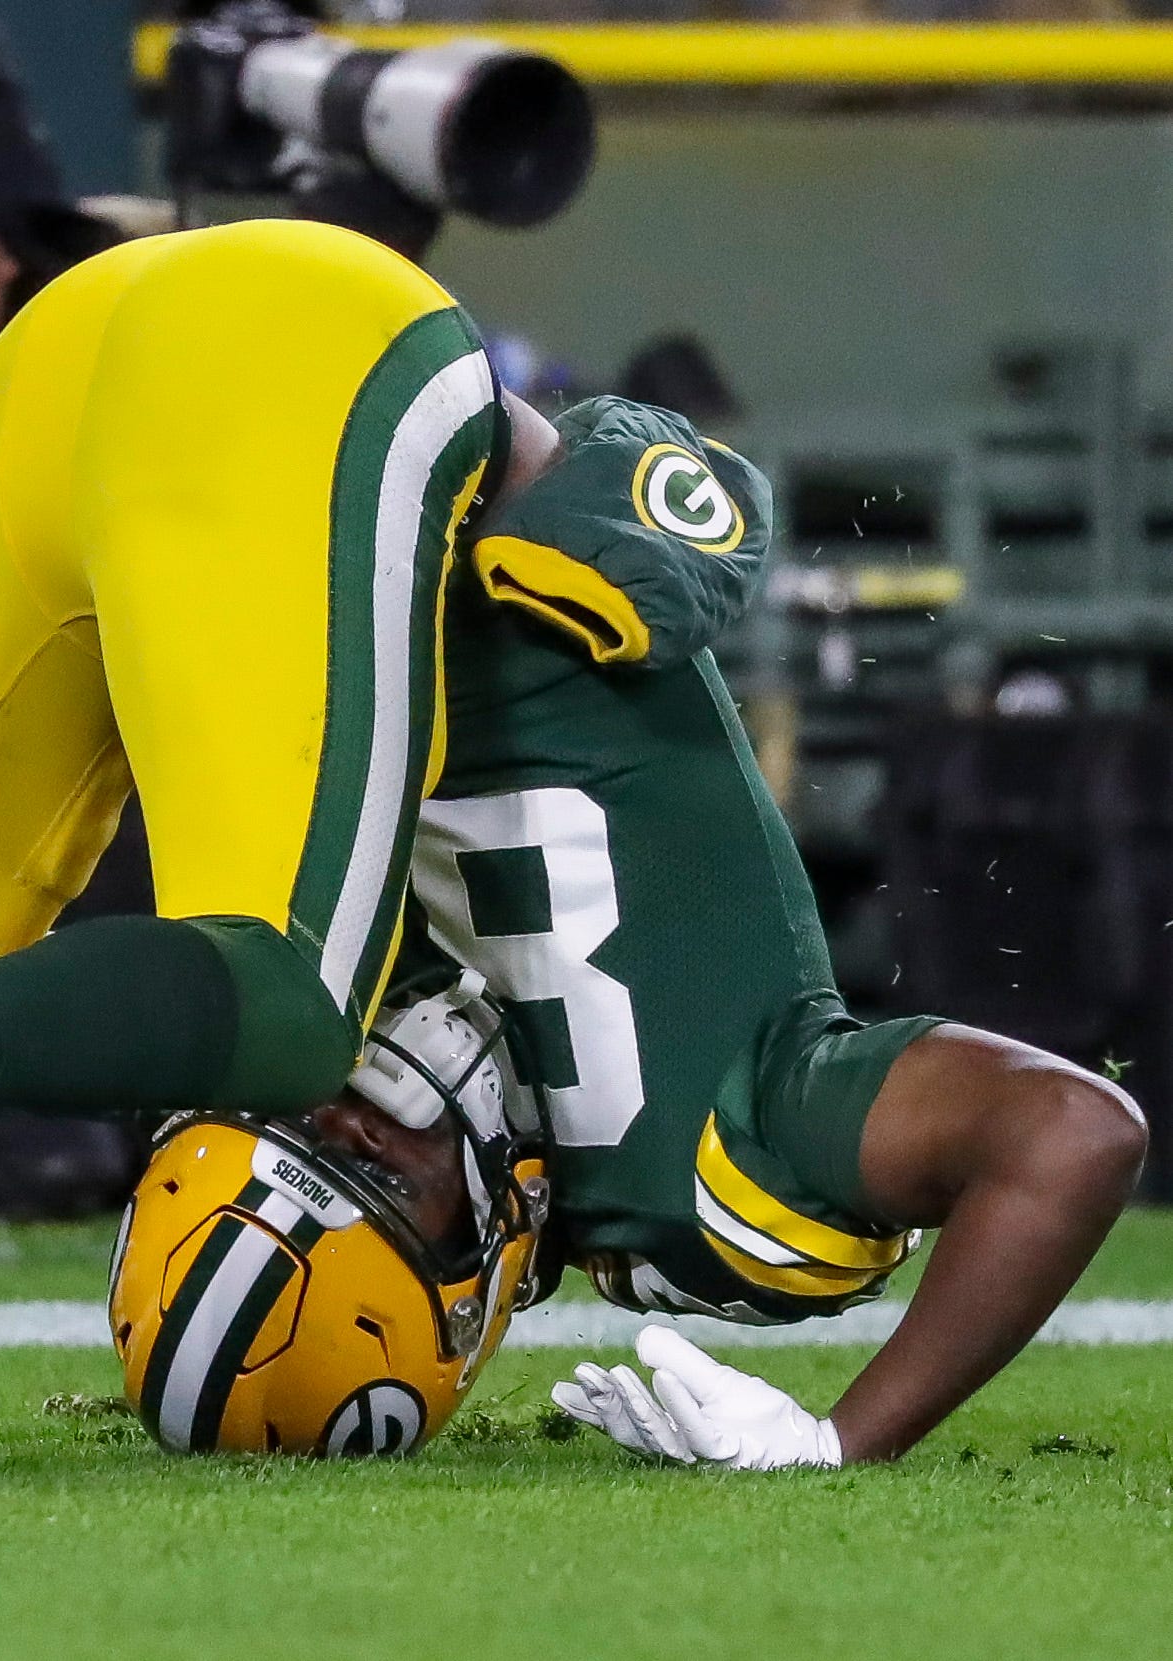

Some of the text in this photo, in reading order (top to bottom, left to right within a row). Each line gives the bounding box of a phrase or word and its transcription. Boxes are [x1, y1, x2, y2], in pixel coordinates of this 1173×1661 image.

[645, 454, 734, 541] G
[411, 787, 645, 1147] 8
[272, 1159, 335, 1211] PACKERS
